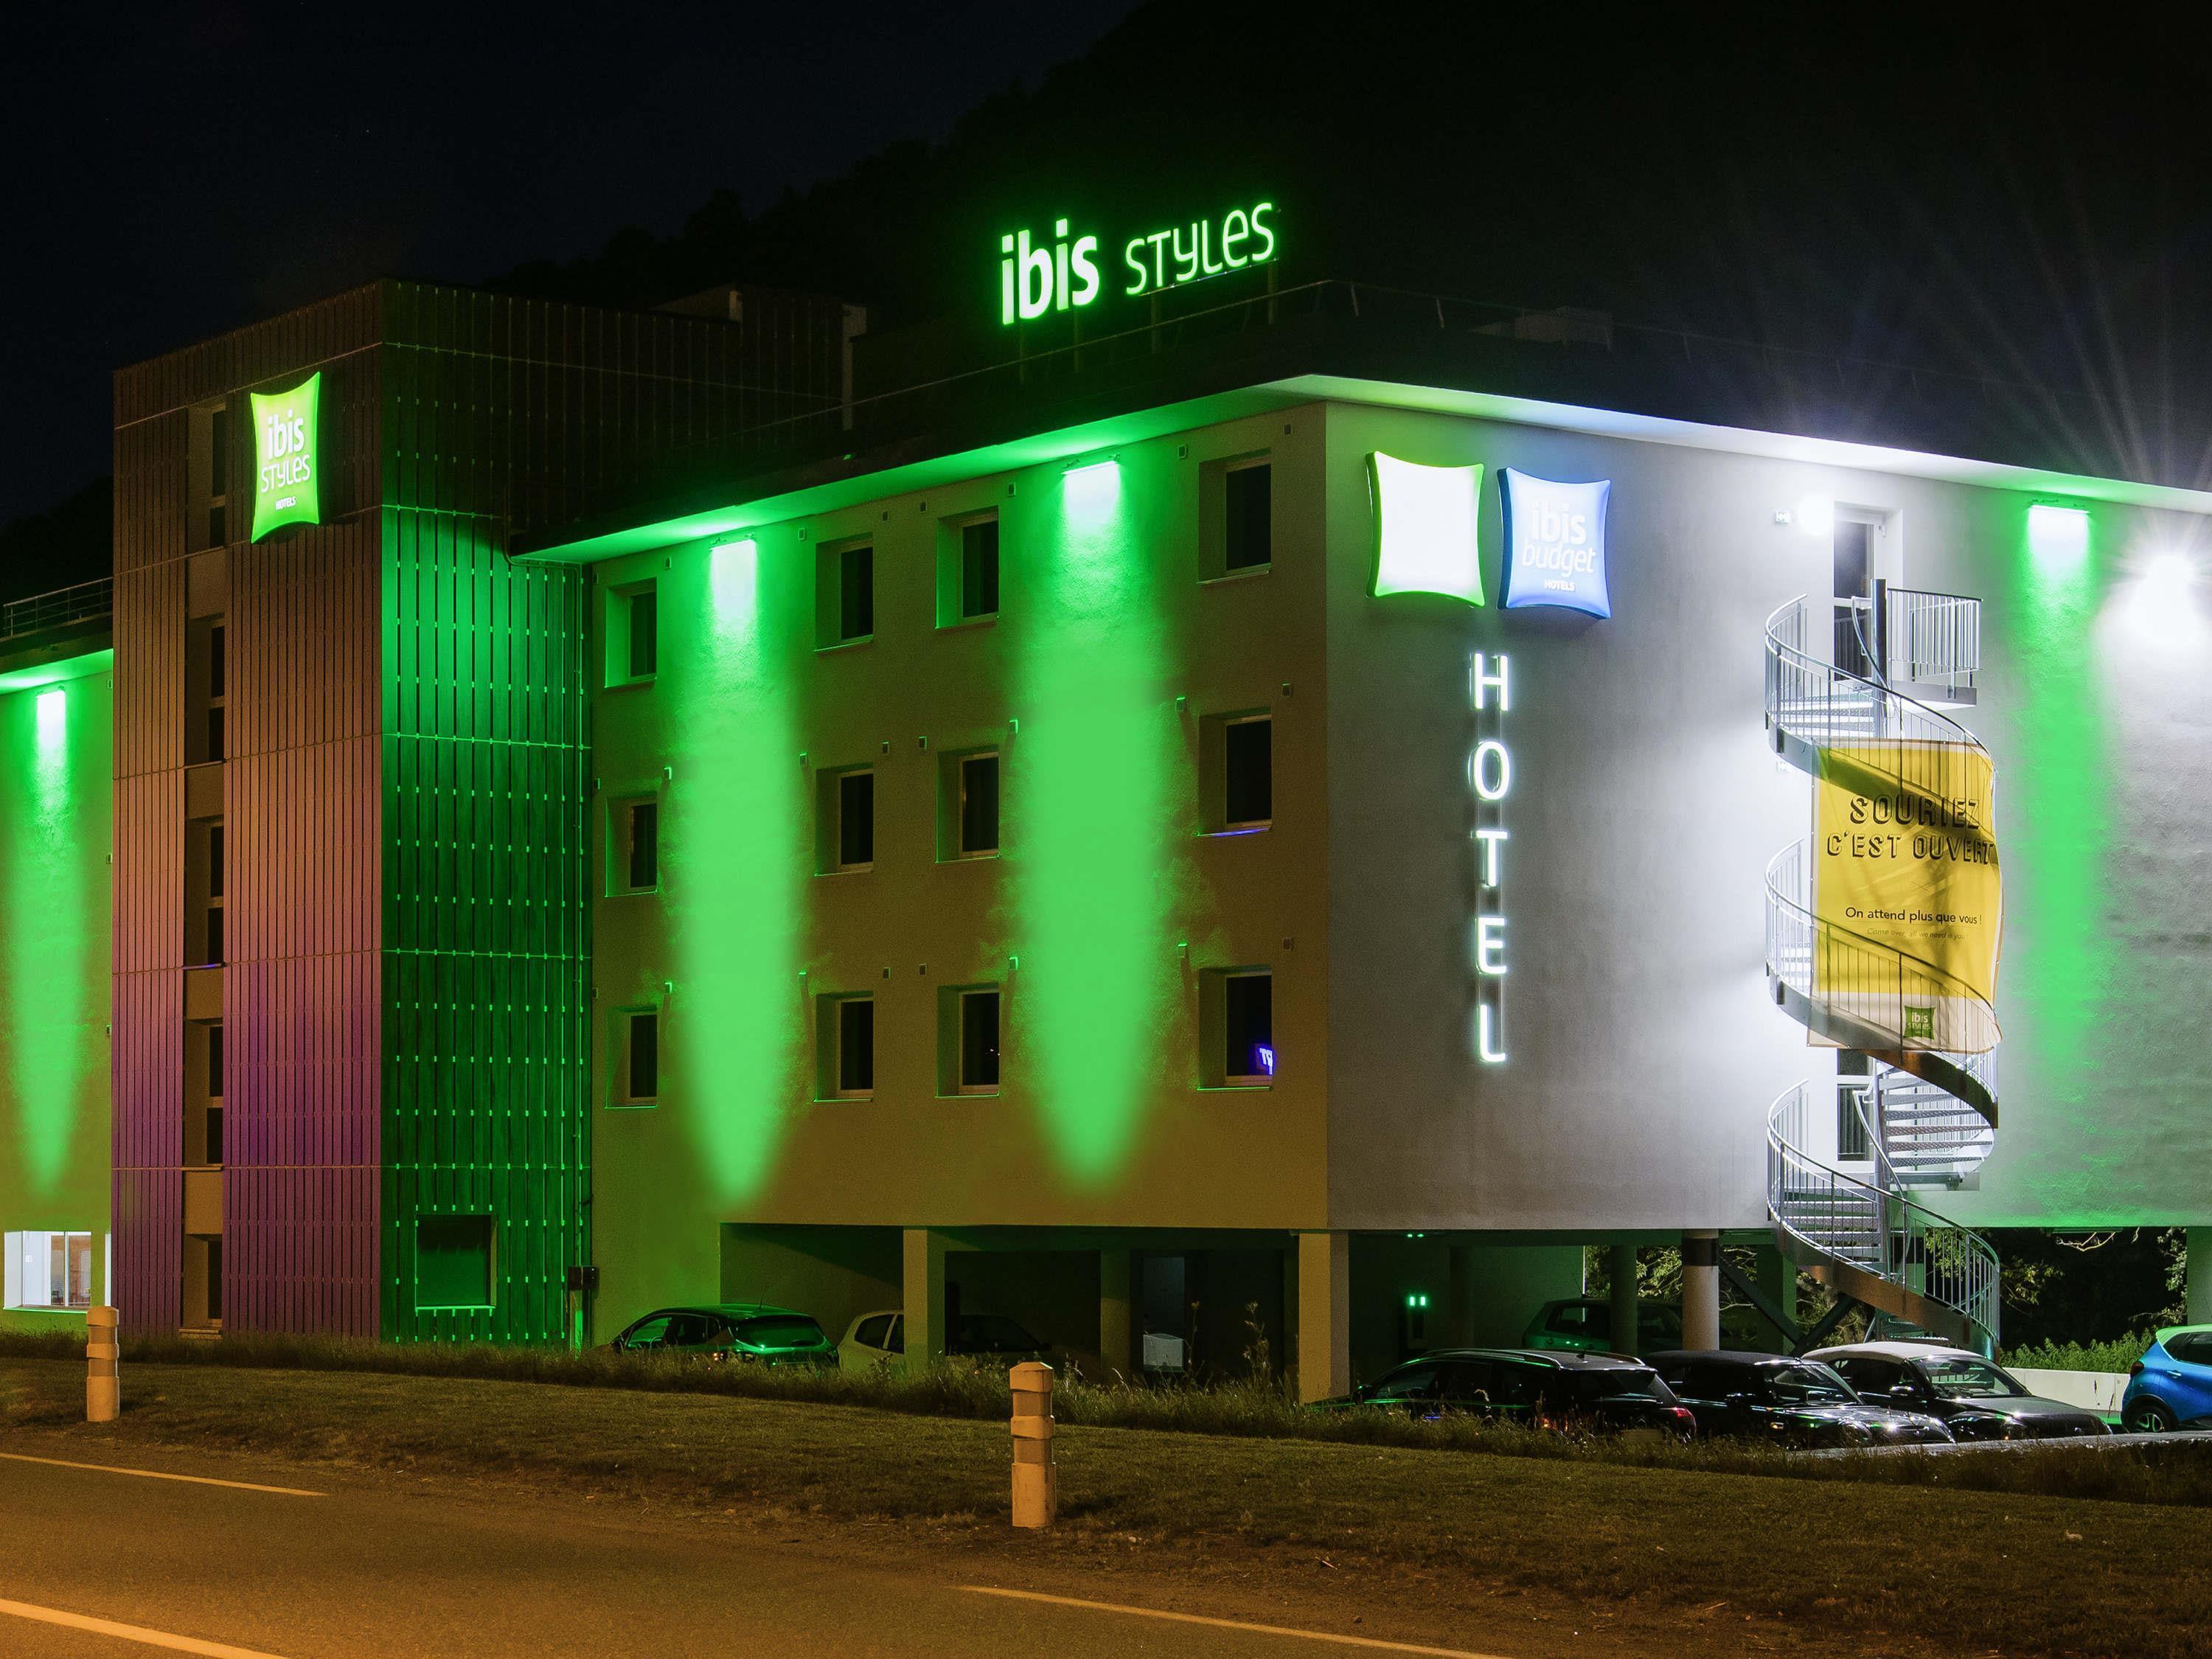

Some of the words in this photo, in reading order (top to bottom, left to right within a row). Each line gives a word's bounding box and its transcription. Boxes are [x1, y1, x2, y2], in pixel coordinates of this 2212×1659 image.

[1001, 218, 1100, 325] ibis
[268, 409, 305, 460] ibis
[275, 496, 296, 511] HOTELS
[1531, 501, 1587, 545] ibis
[1521, 537, 1597, 577] budget
[1544, 579, 1576, 591] HOTELS
[1849, 793, 1980, 830] SOURIEZ
[1473, 653, 1510, 1062] HOTEL
[1826, 830, 1902, 858] C'EST
[1846, 907, 1863, 919] On
[1867, 909, 1905, 921] attend
[1909, 909, 1933, 924] plus
[1935, 914, 1956, 925] que
[1958, 915, 1978, 925] vous
